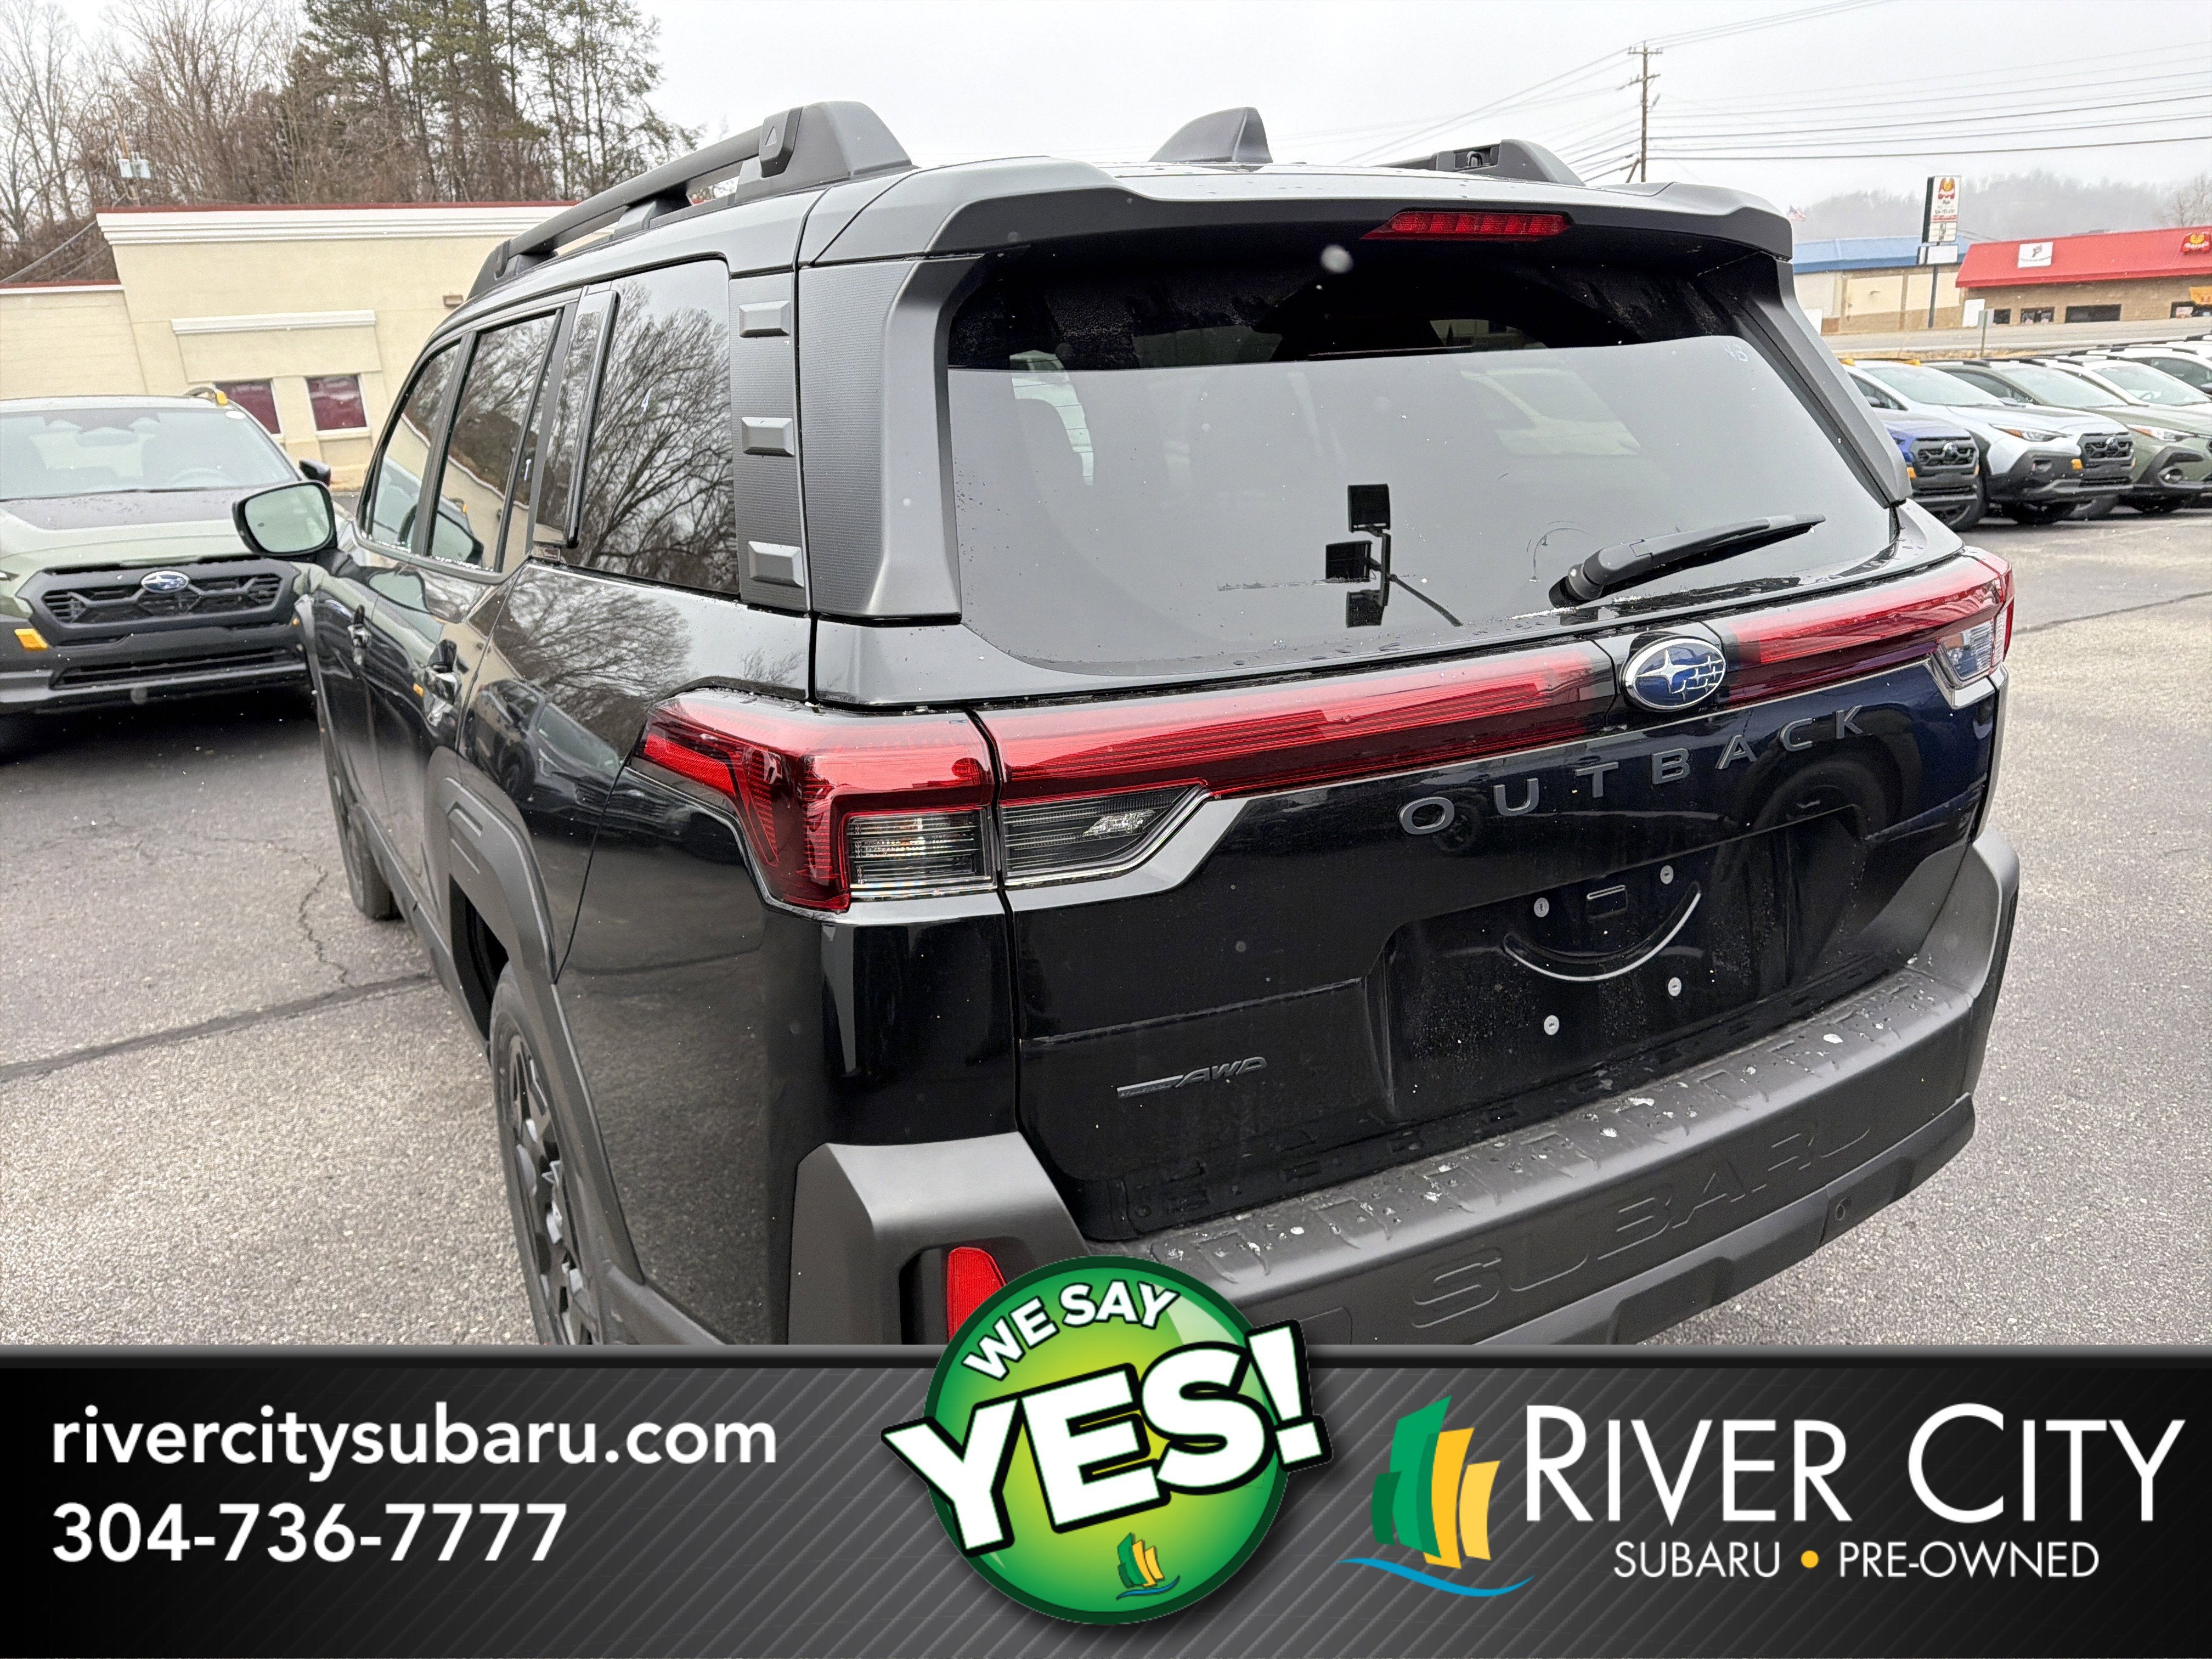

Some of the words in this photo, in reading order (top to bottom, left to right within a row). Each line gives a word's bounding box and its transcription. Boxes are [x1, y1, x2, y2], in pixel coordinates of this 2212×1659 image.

[1399, 704, 1864, 836] OUTBACK
[1175, 1056, 1267, 1088] AWD
[1411, 1114, 1872, 1329] SUBARU
